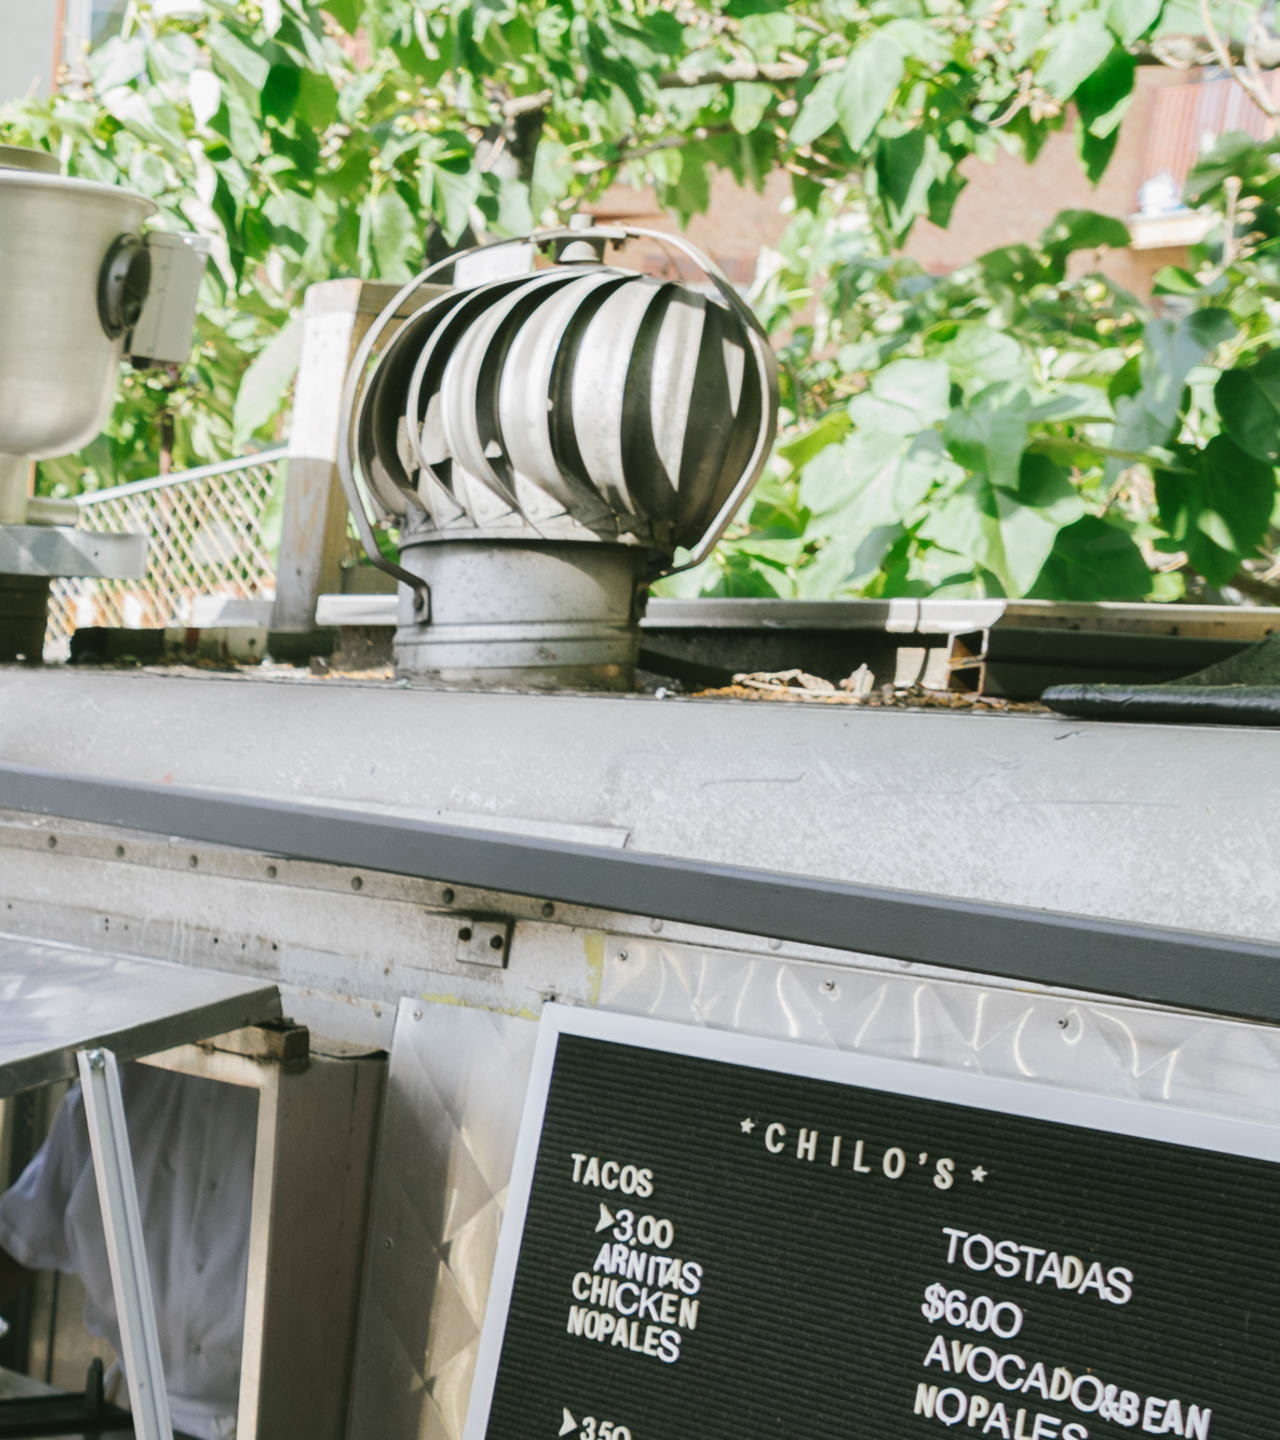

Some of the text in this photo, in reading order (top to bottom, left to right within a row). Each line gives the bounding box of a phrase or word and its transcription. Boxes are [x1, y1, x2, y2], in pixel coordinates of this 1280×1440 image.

[570, 1152, 654, 1198] TACOS
[765, 1122, 955, 1190] CHILO'S
[613, 1208, 674, 1250] 3.00
[592, 1242, 703, 1295] ARNITAS
[942, 1227, 1134, 1305] TOSTADAS
[572, 1271, 700, 1330] CHICKEN
[921, 1282, 1023, 1338] $6.00
[566, 1304, 682, 1364] NOPALES
